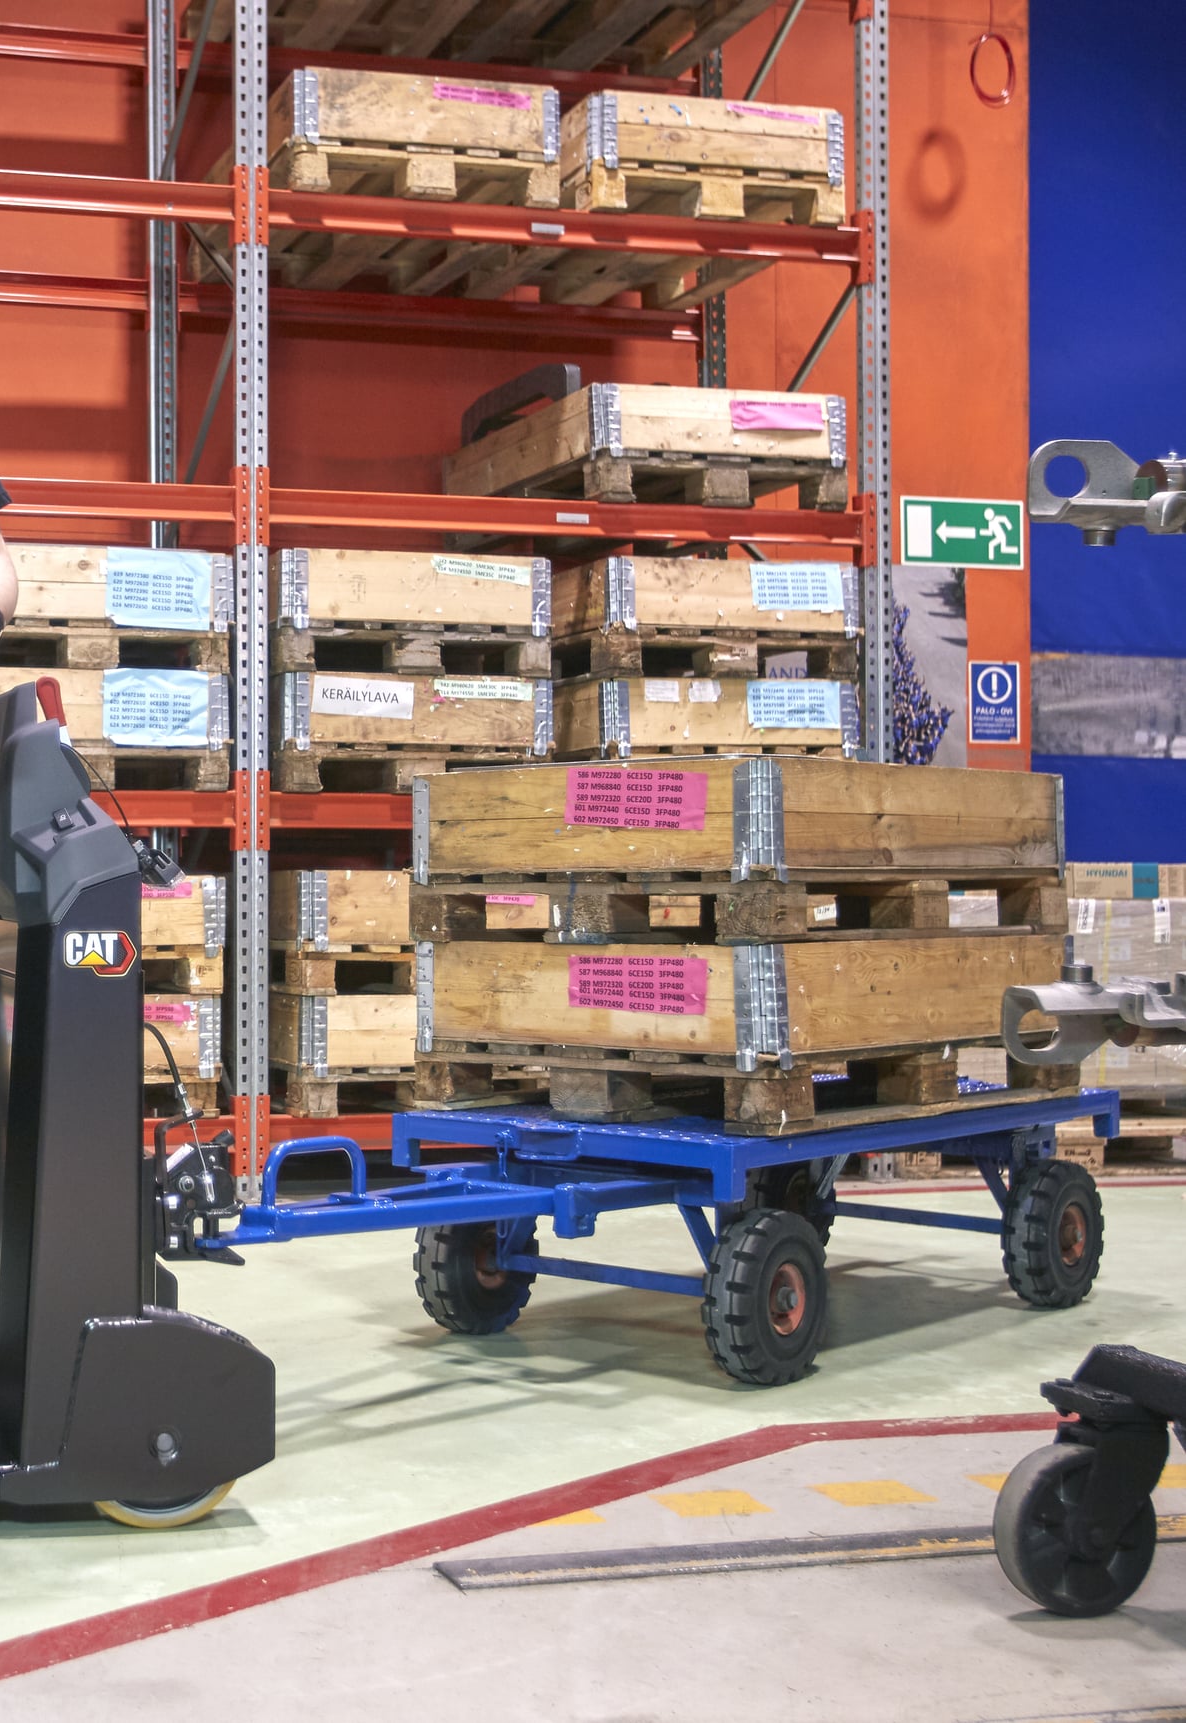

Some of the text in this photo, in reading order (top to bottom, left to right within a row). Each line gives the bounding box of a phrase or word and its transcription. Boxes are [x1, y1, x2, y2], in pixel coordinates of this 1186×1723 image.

[322, 687, 399, 703] KERÄILYLAVA
[591, 771, 621, 779] M972280
[627, 772, 653, 780] 6CE15D
[591, 783, 621, 791] M968840
[626, 784, 652, 792] 6CE15D
[590, 794, 621, 802] M972320
[657, 796, 682, 804] 3FP480
[574, 804, 680, 817] 601 M972440 6CE15D 3FP480
[574, 815, 680, 828] 602 M972450 6CE15D 3FP480
[1086, 869, 1128, 877] HYUNDAI
[66, 933, 118, 965] CAT
[579, 968, 590, 976] 587
[592, 969, 623, 977] M968840
[592, 980, 623, 988] M972320
[592, 988, 624, 996] M972440
[629, 990, 655, 999] 6CE15D
[660, 993, 685, 1001] 3FP480
[593, 999, 624, 1008] M972450
[629, 1003, 654, 1011] 6CE15D
[659, 1005, 684, 1013] 3FP480
